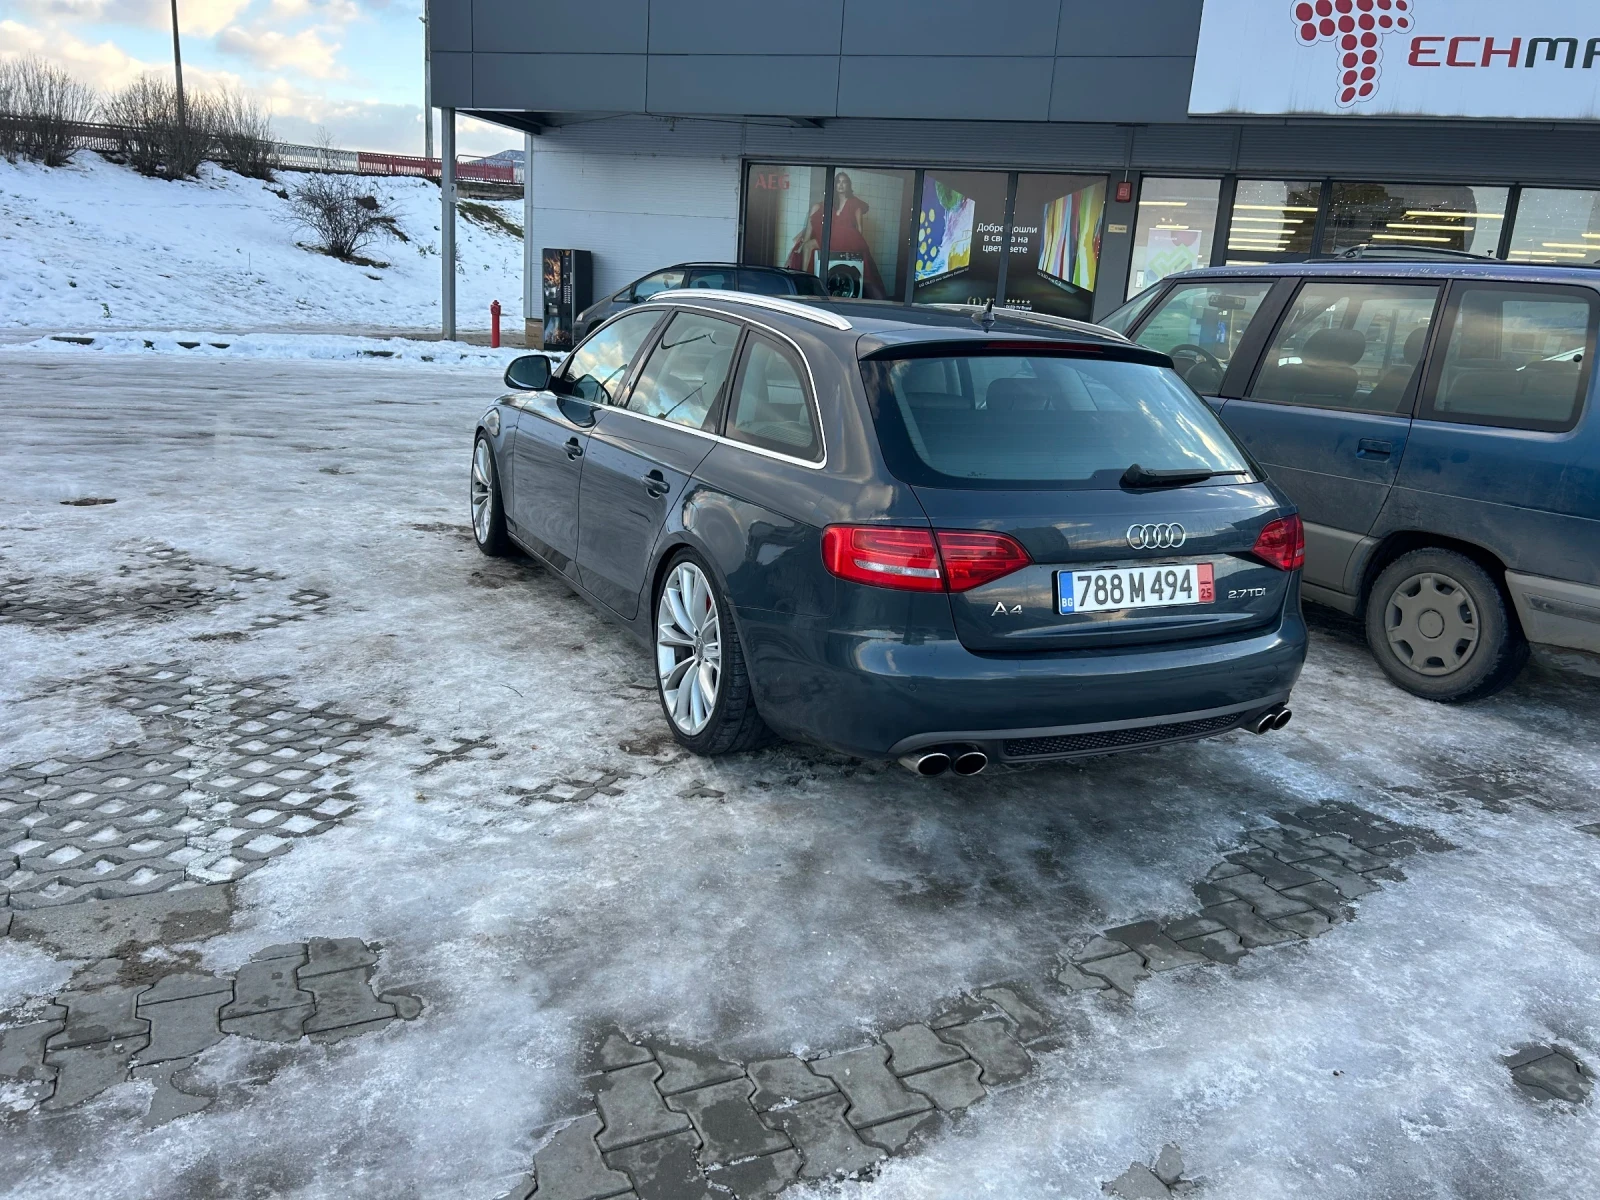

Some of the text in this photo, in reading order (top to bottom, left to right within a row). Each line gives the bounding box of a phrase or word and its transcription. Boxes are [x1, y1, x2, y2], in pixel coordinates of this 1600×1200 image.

[754, 173, 790, 190] AEG
[1011, 226, 1038, 235] ошли
[1017, 236, 1029, 244] на
[1200, 588, 1212, 598] 25
[1061, 597, 1073, 607] BG
[991, 601, 1022, 617] A4
